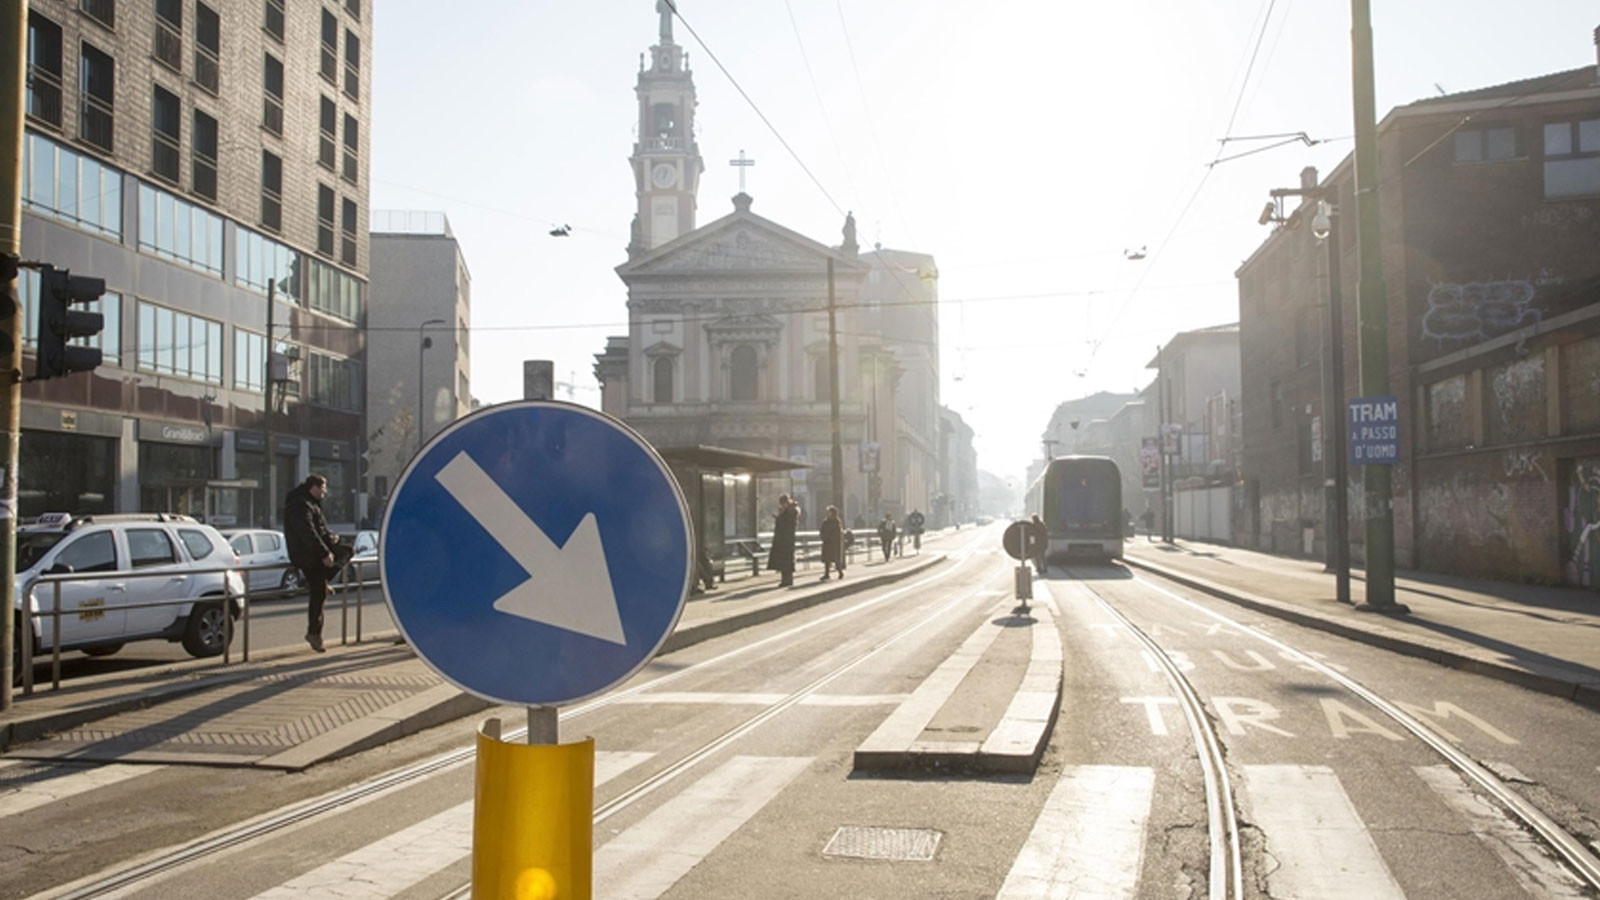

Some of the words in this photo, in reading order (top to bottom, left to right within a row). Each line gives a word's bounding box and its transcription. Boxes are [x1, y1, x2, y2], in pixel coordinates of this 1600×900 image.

[1349, 402, 1397, 422] TRAM
[1361, 426, 1396, 440] PASSO
[1355, 444, 1396, 459] D'UOMO
[1141, 650, 1349, 673] BUS
[1119, 696, 1521, 745] TRAM
